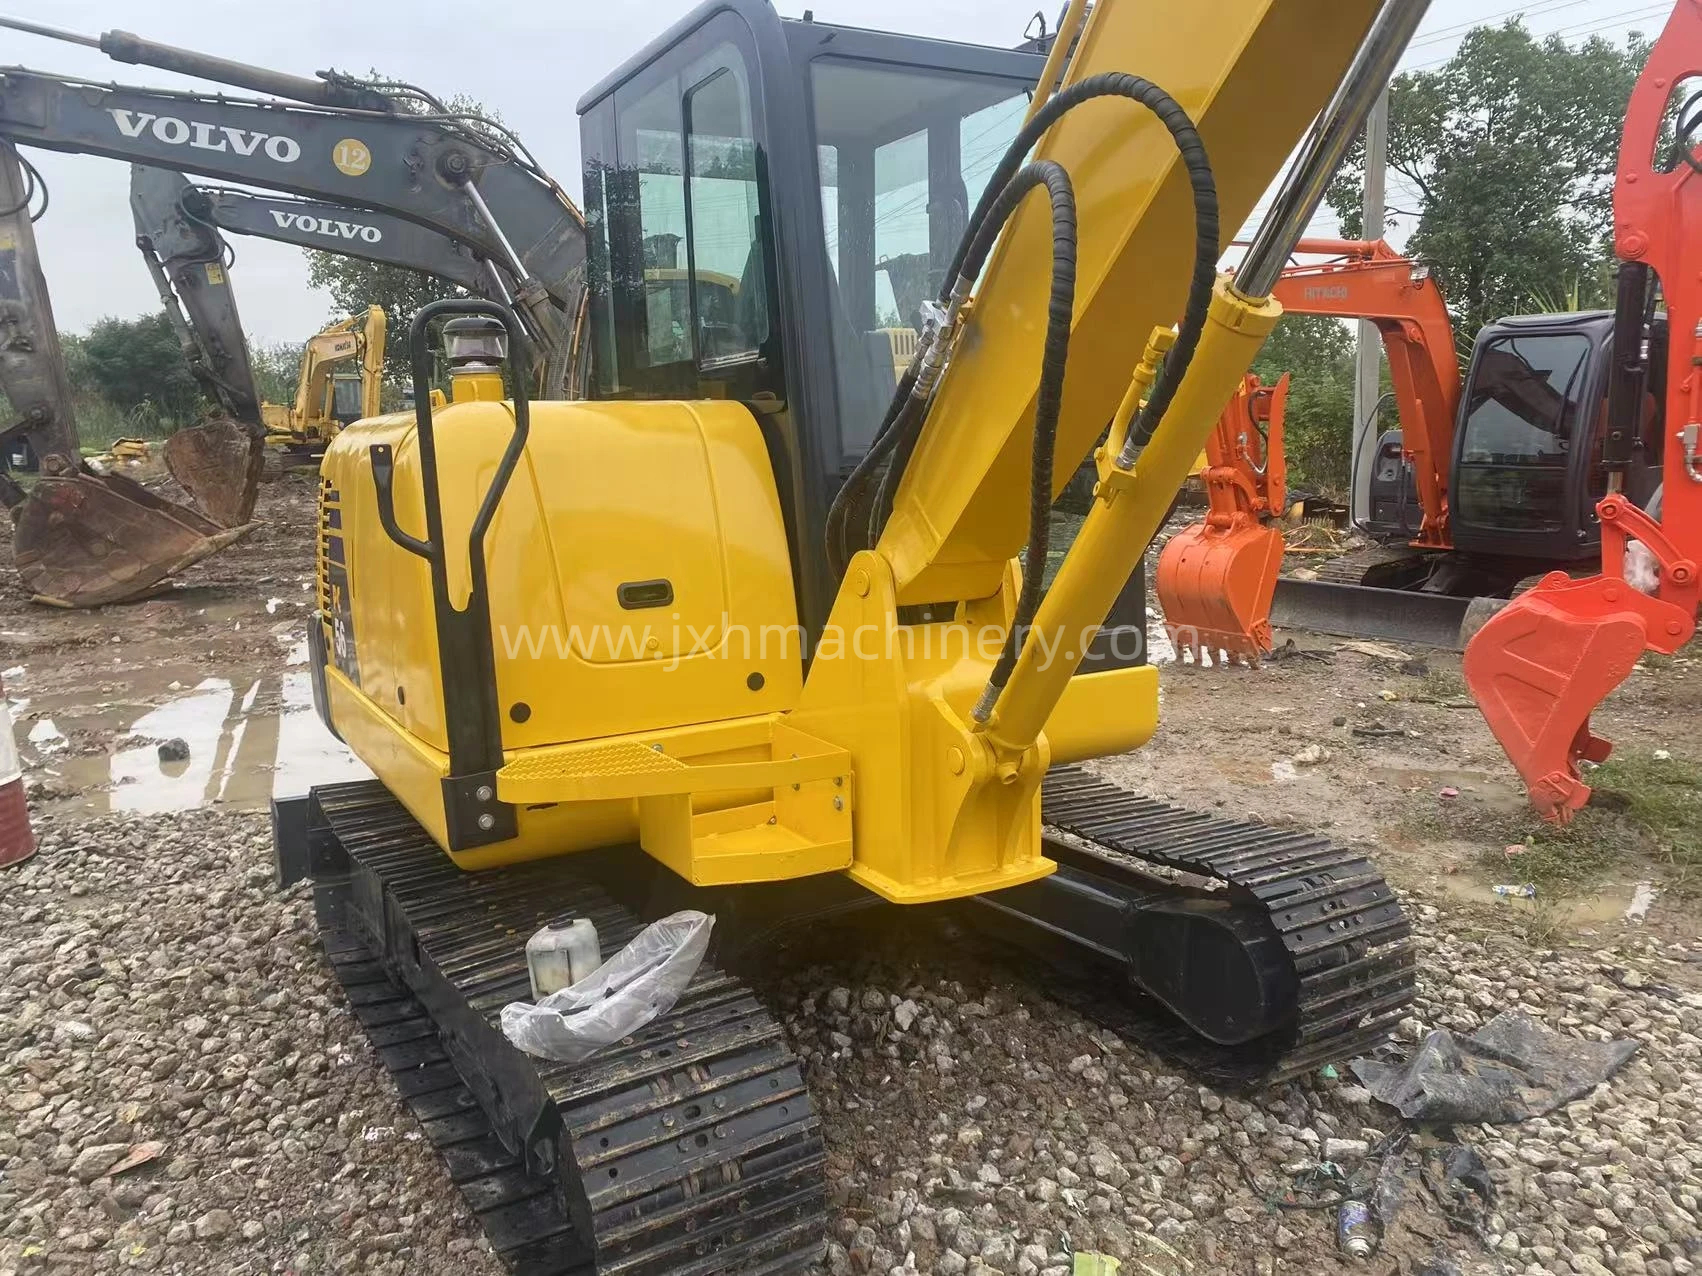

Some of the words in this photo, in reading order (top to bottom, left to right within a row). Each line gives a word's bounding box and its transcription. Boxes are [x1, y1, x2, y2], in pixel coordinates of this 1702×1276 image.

[107, 108, 301, 163] VOLVO
[340, 146, 368, 170] 12
[269, 210, 382, 243] VOLVO
